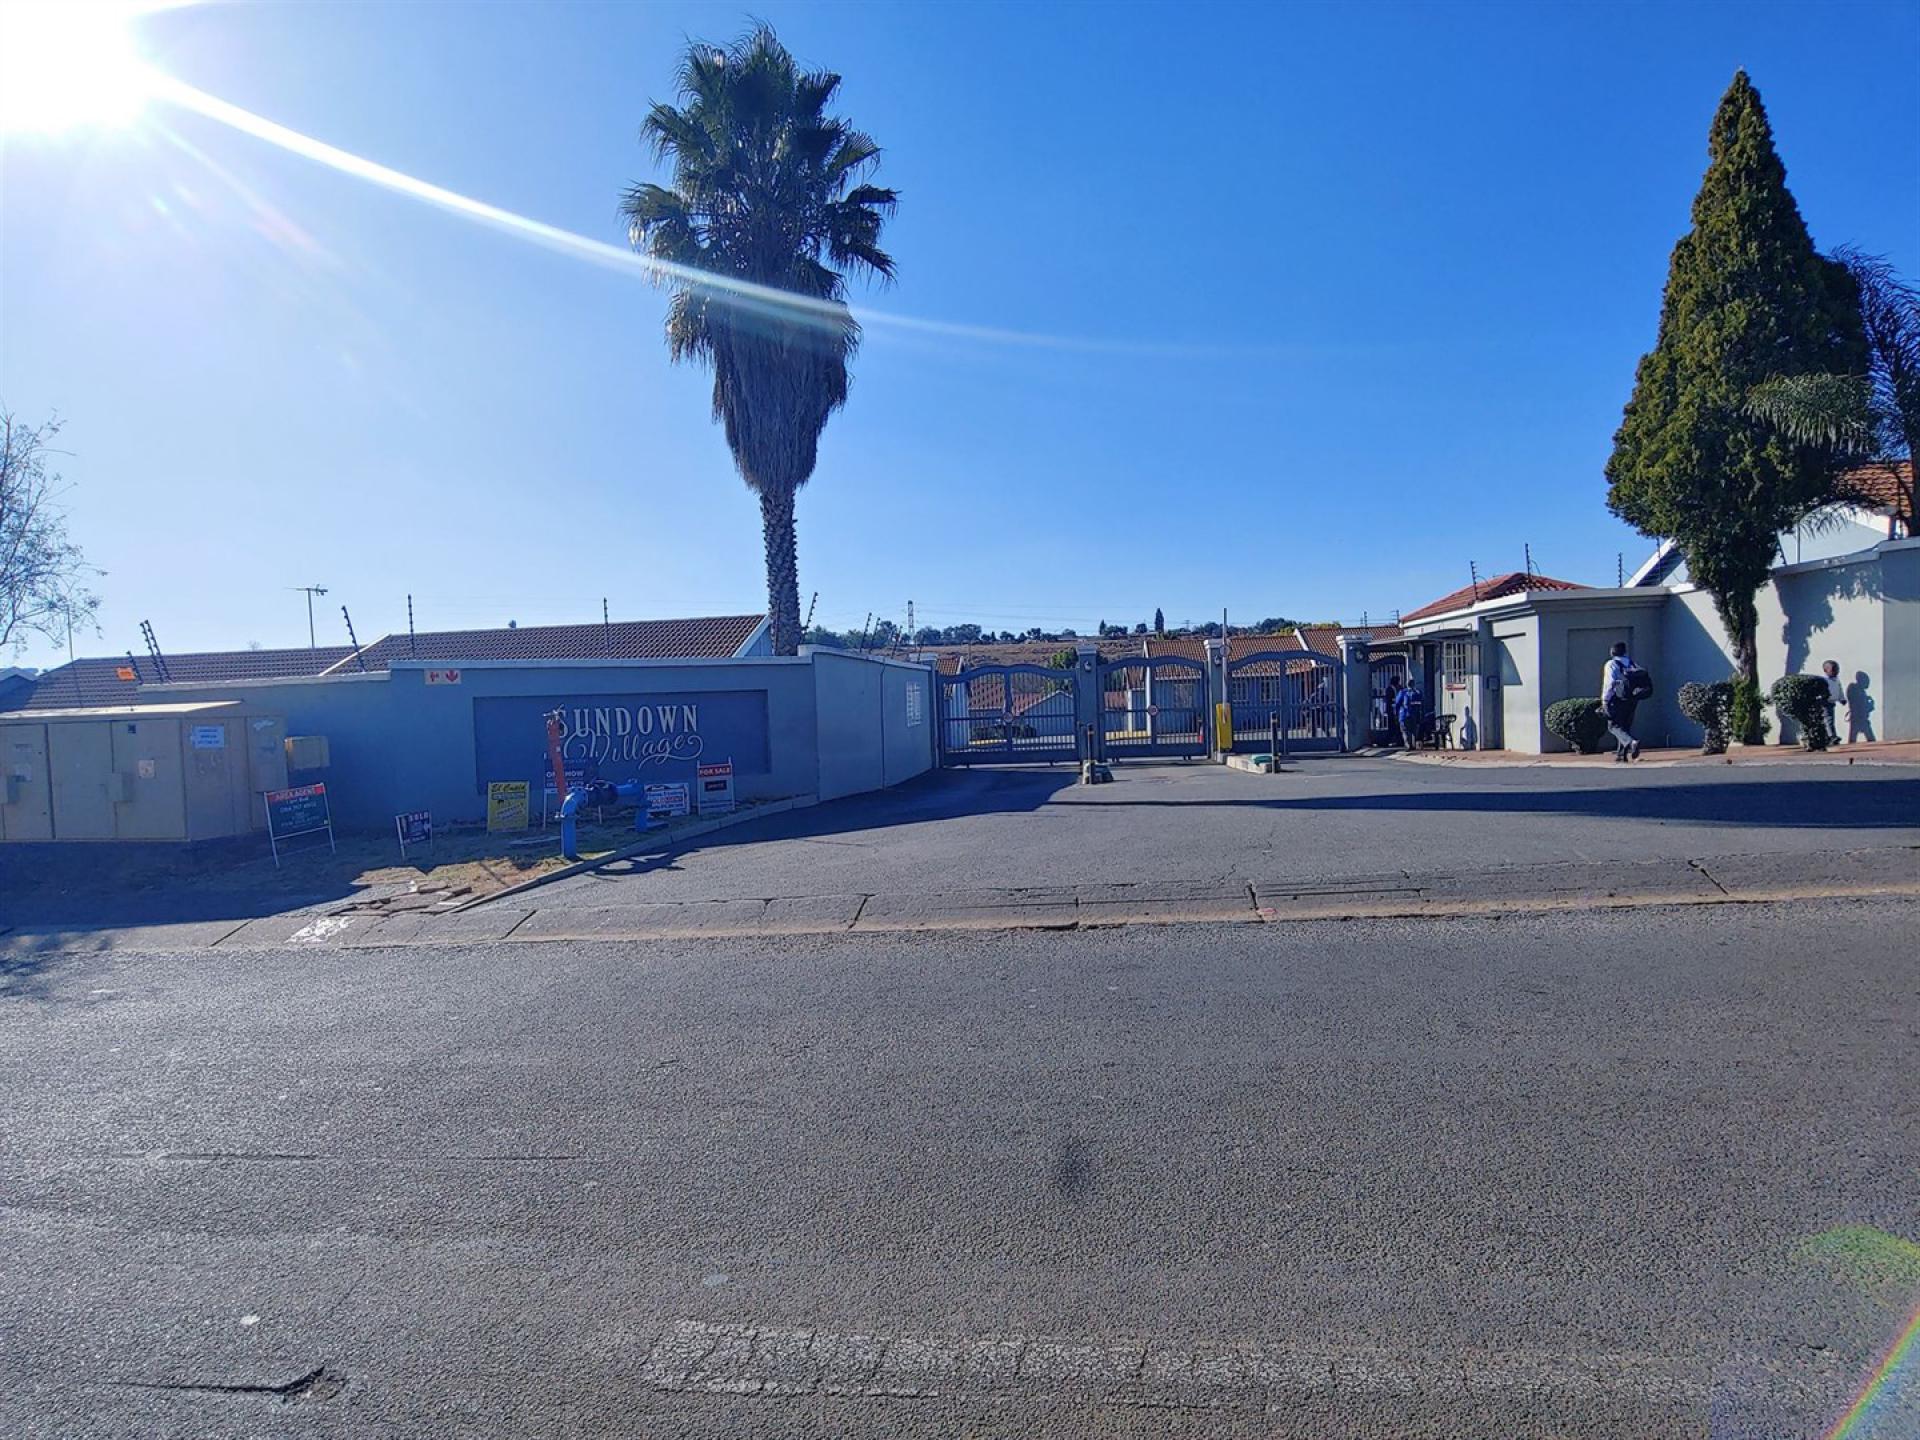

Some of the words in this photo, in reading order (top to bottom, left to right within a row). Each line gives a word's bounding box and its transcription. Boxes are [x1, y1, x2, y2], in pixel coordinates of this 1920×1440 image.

[558, 705, 697, 738] SUNDOWN
[563, 728, 704, 770] Village
[715, 767, 730, 775] SALE
